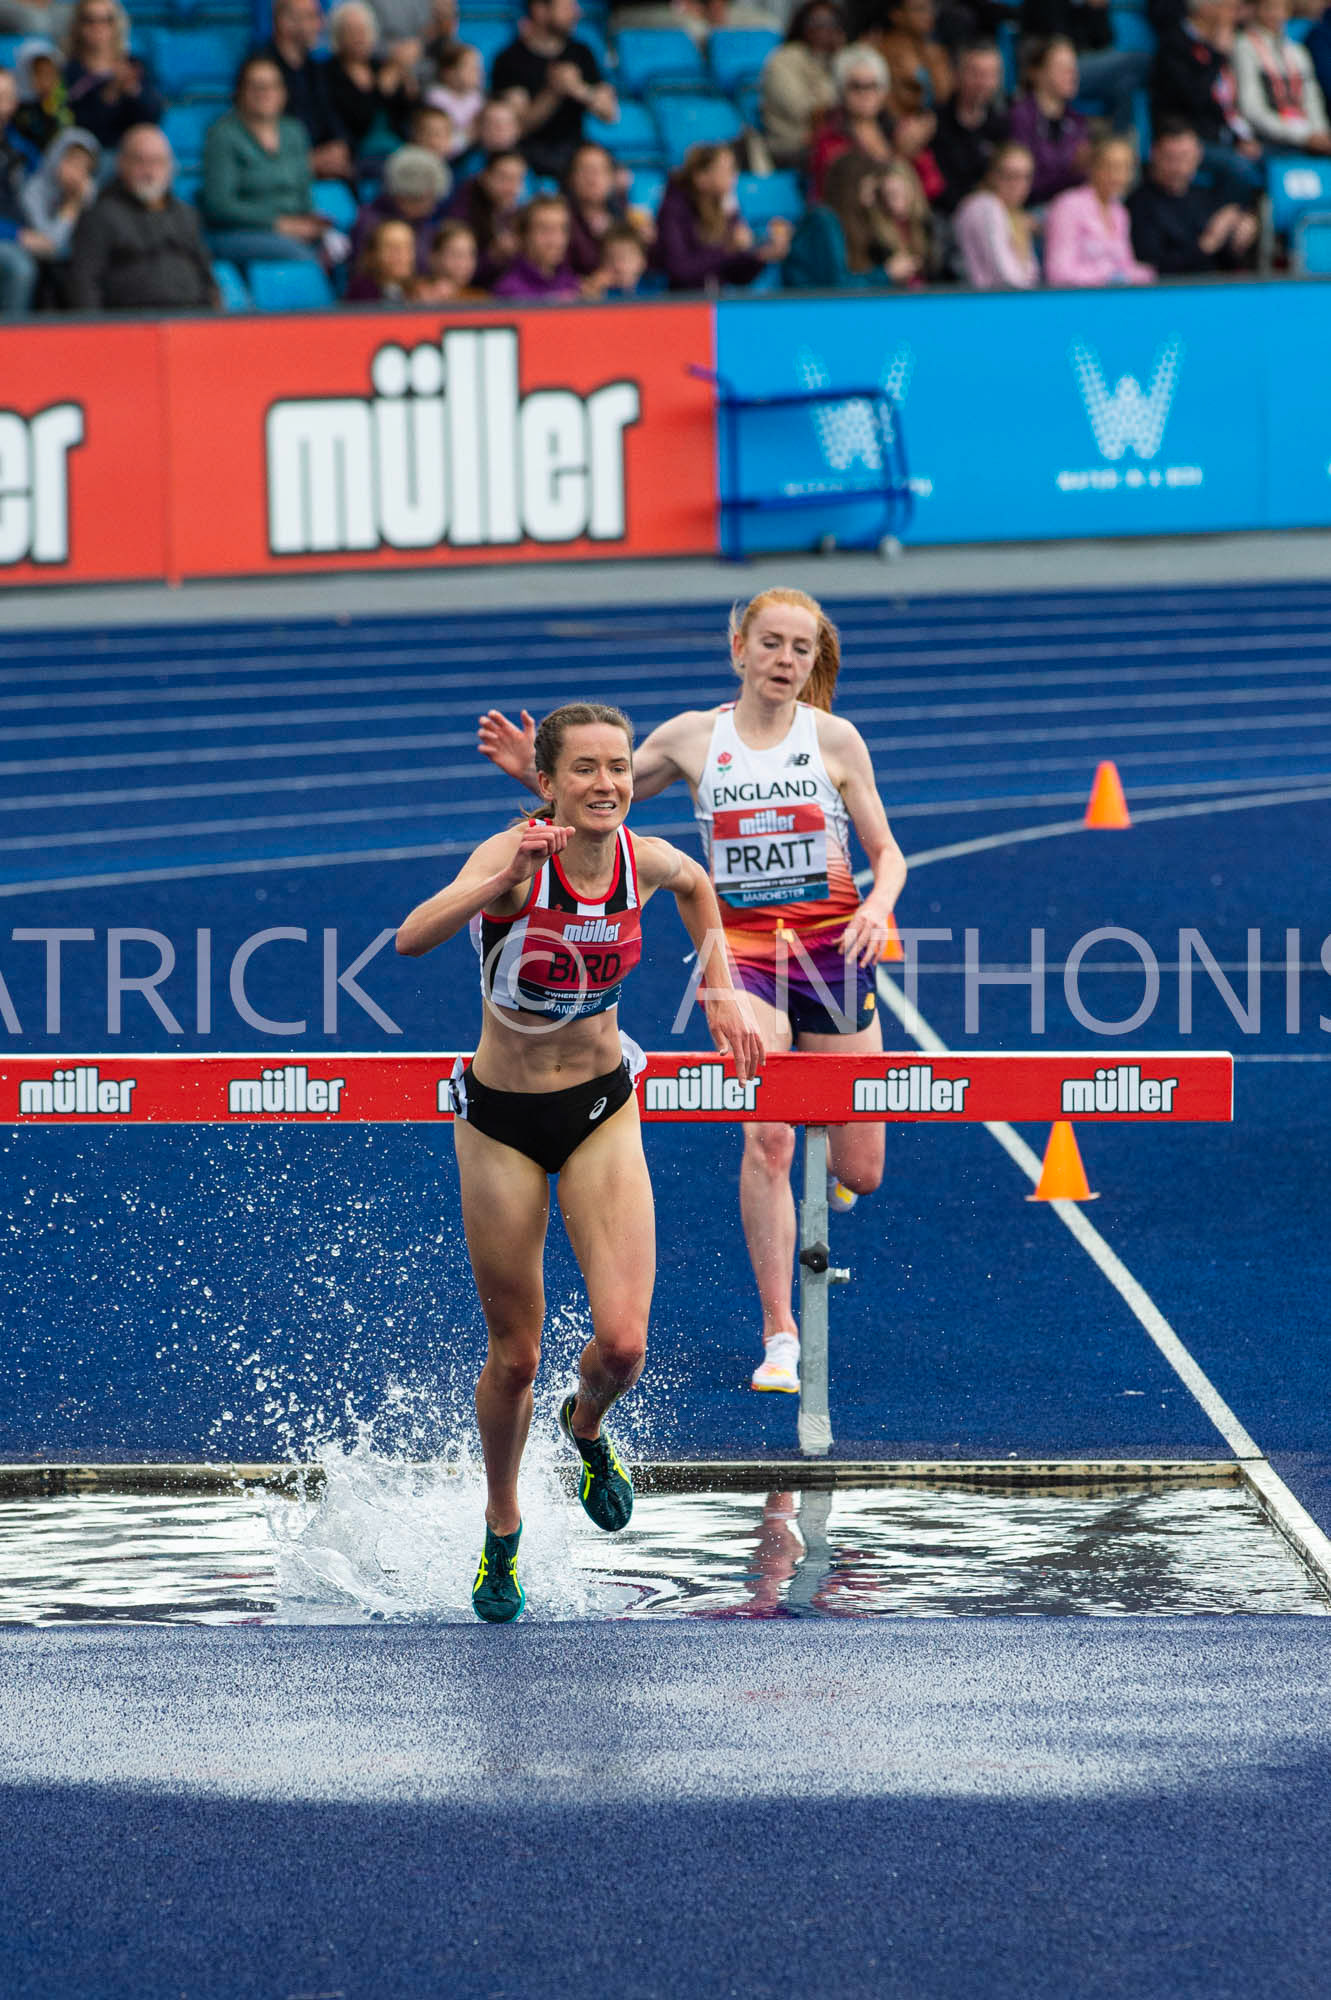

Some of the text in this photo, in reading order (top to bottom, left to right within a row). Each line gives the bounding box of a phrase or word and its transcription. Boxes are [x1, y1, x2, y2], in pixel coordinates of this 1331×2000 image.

[265, 326, 640, 555] müller
[713, 780, 817, 807] ENGLAND
[739, 809, 795, 835] müller
[726, 839, 815, 874] PRATT
[742, 887, 805, 903] MANCHESTER
[562, 918, 622, 944] müller
[547, 951, 622, 984] BIRD
[19, 1066, 137, 1114] müller
[228, 1065, 346, 1114] müller
[853, 1065, 970, 1113] müller
[1061, 1065, 1178, 1113] müller
